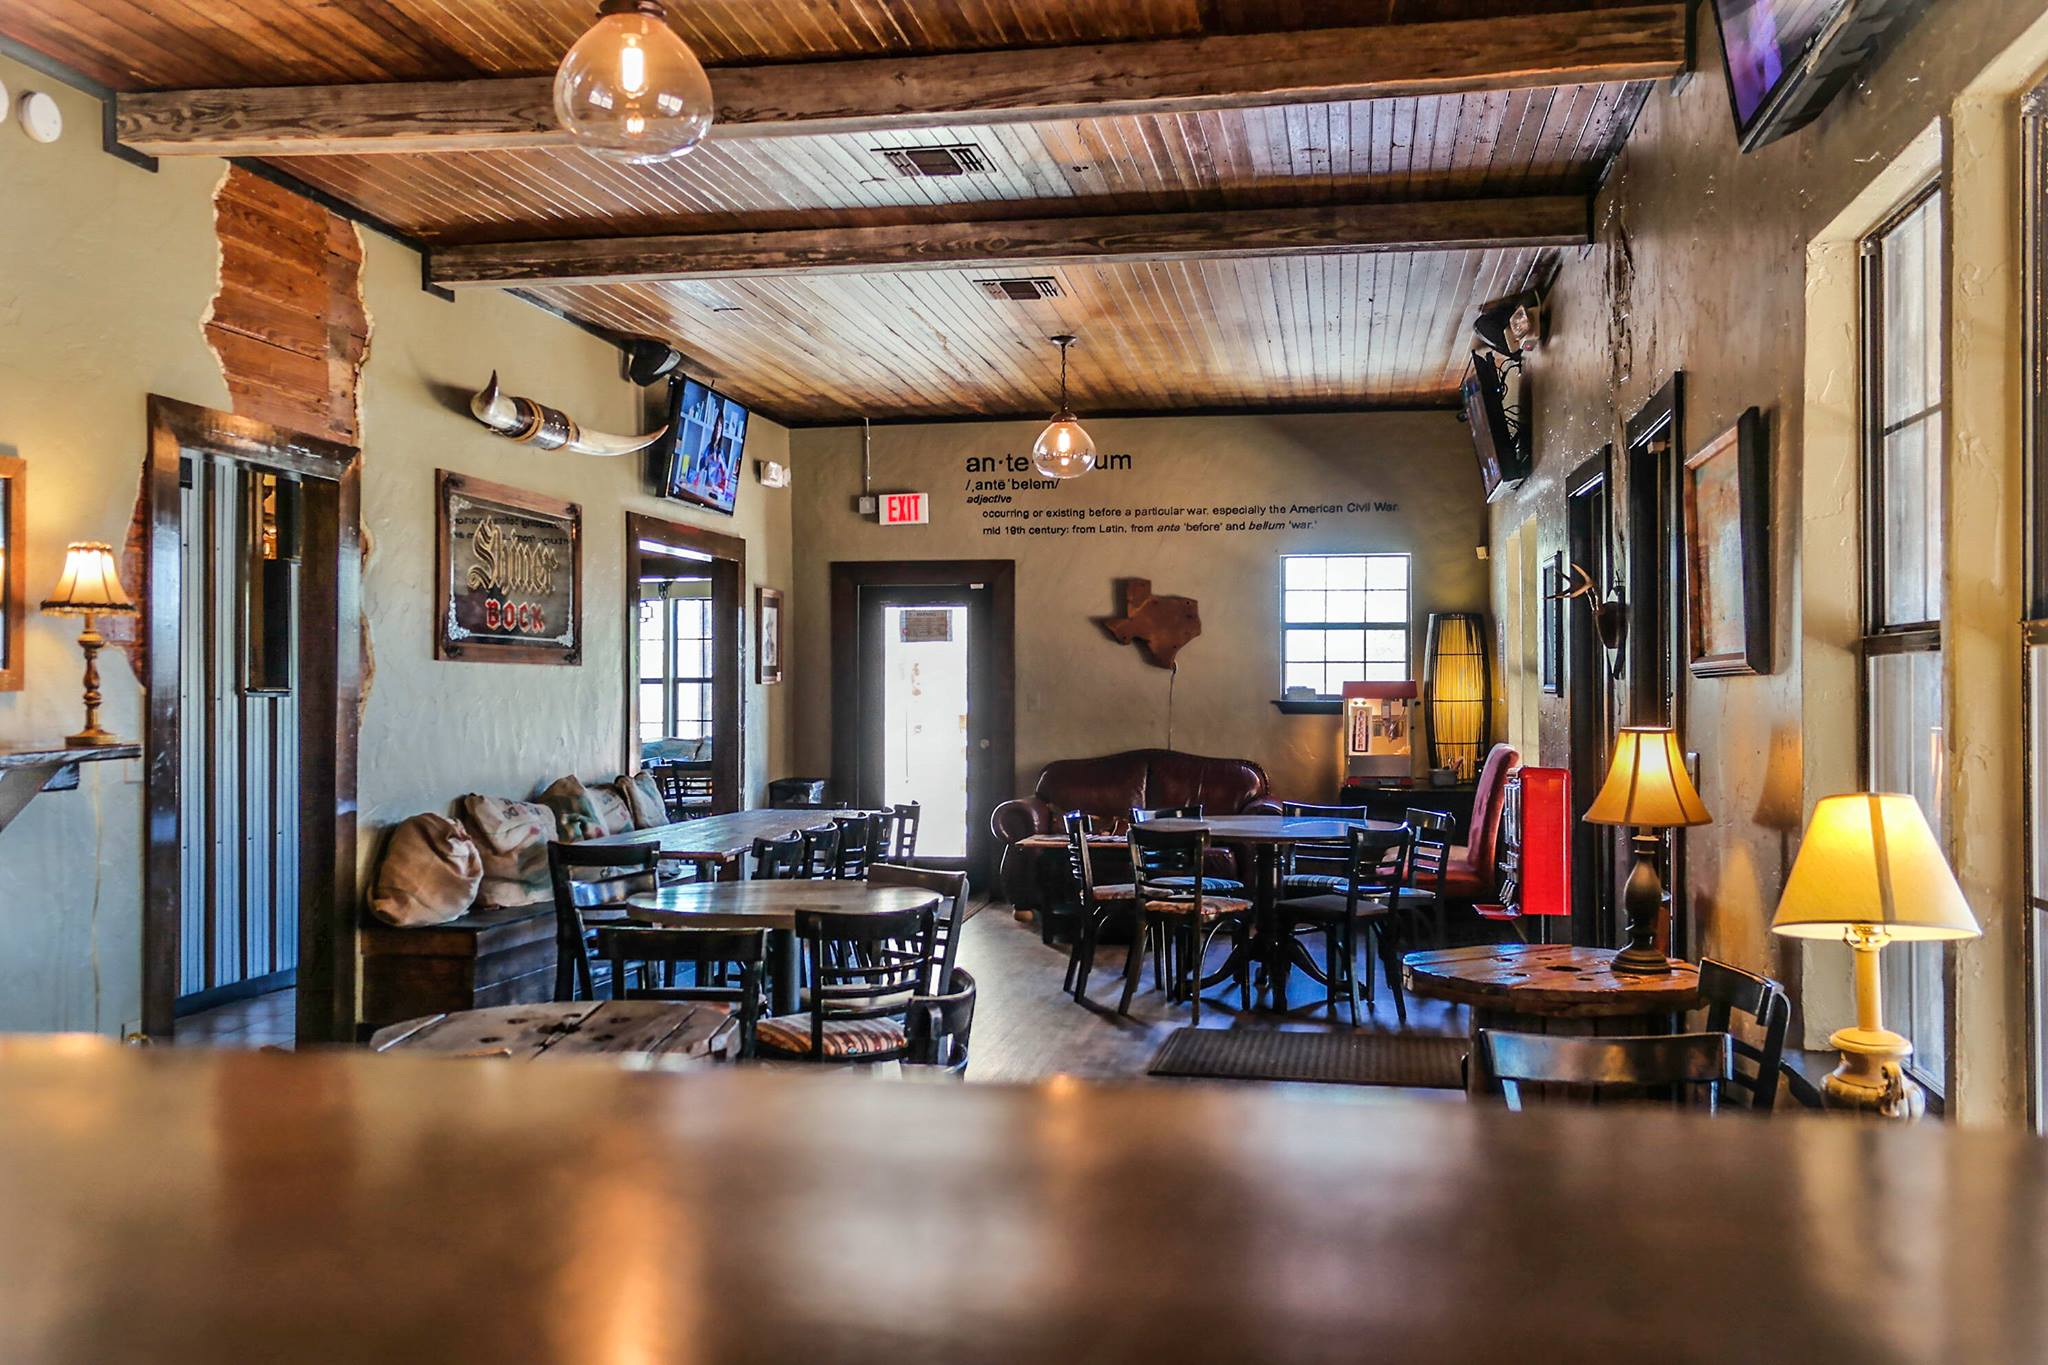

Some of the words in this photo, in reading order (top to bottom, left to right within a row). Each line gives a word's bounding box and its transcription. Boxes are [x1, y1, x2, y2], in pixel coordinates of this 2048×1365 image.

[888, 495, 920, 522] EXIT
[966, 494, 1012, 506] adjective
[982, 508, 1029, 519] occurring
[1032, 510, 1043, 518] or
[1046, 508, 1085, 519] existing
[1088, 507, 1122, 517] before
[1124, 508, 1132, 516] a
[1134, 506, 1184, 518] particular
[1212, 504, 1267, 516] especially
[1269, 504, 1287, 514] the
[1289, 503, 1343, 514] American
[1346, 502, 1371, 513] Civil
[982, 526, 1001, 535] mid
[1005, 525, 1026, 535] 19th
[1028, 525, 1069, 536] century:
[1072, 524, 1096, 534] from
[1131, 523, 1154, 533] from
[1156, 523, 1181, 532] ante
[1225, 521, 1246, 531] and
[1248, 520, 1286, 531] bellum
[466, 515, 560, 595] Shiner
[485, 598, 546, 633] BOCK
